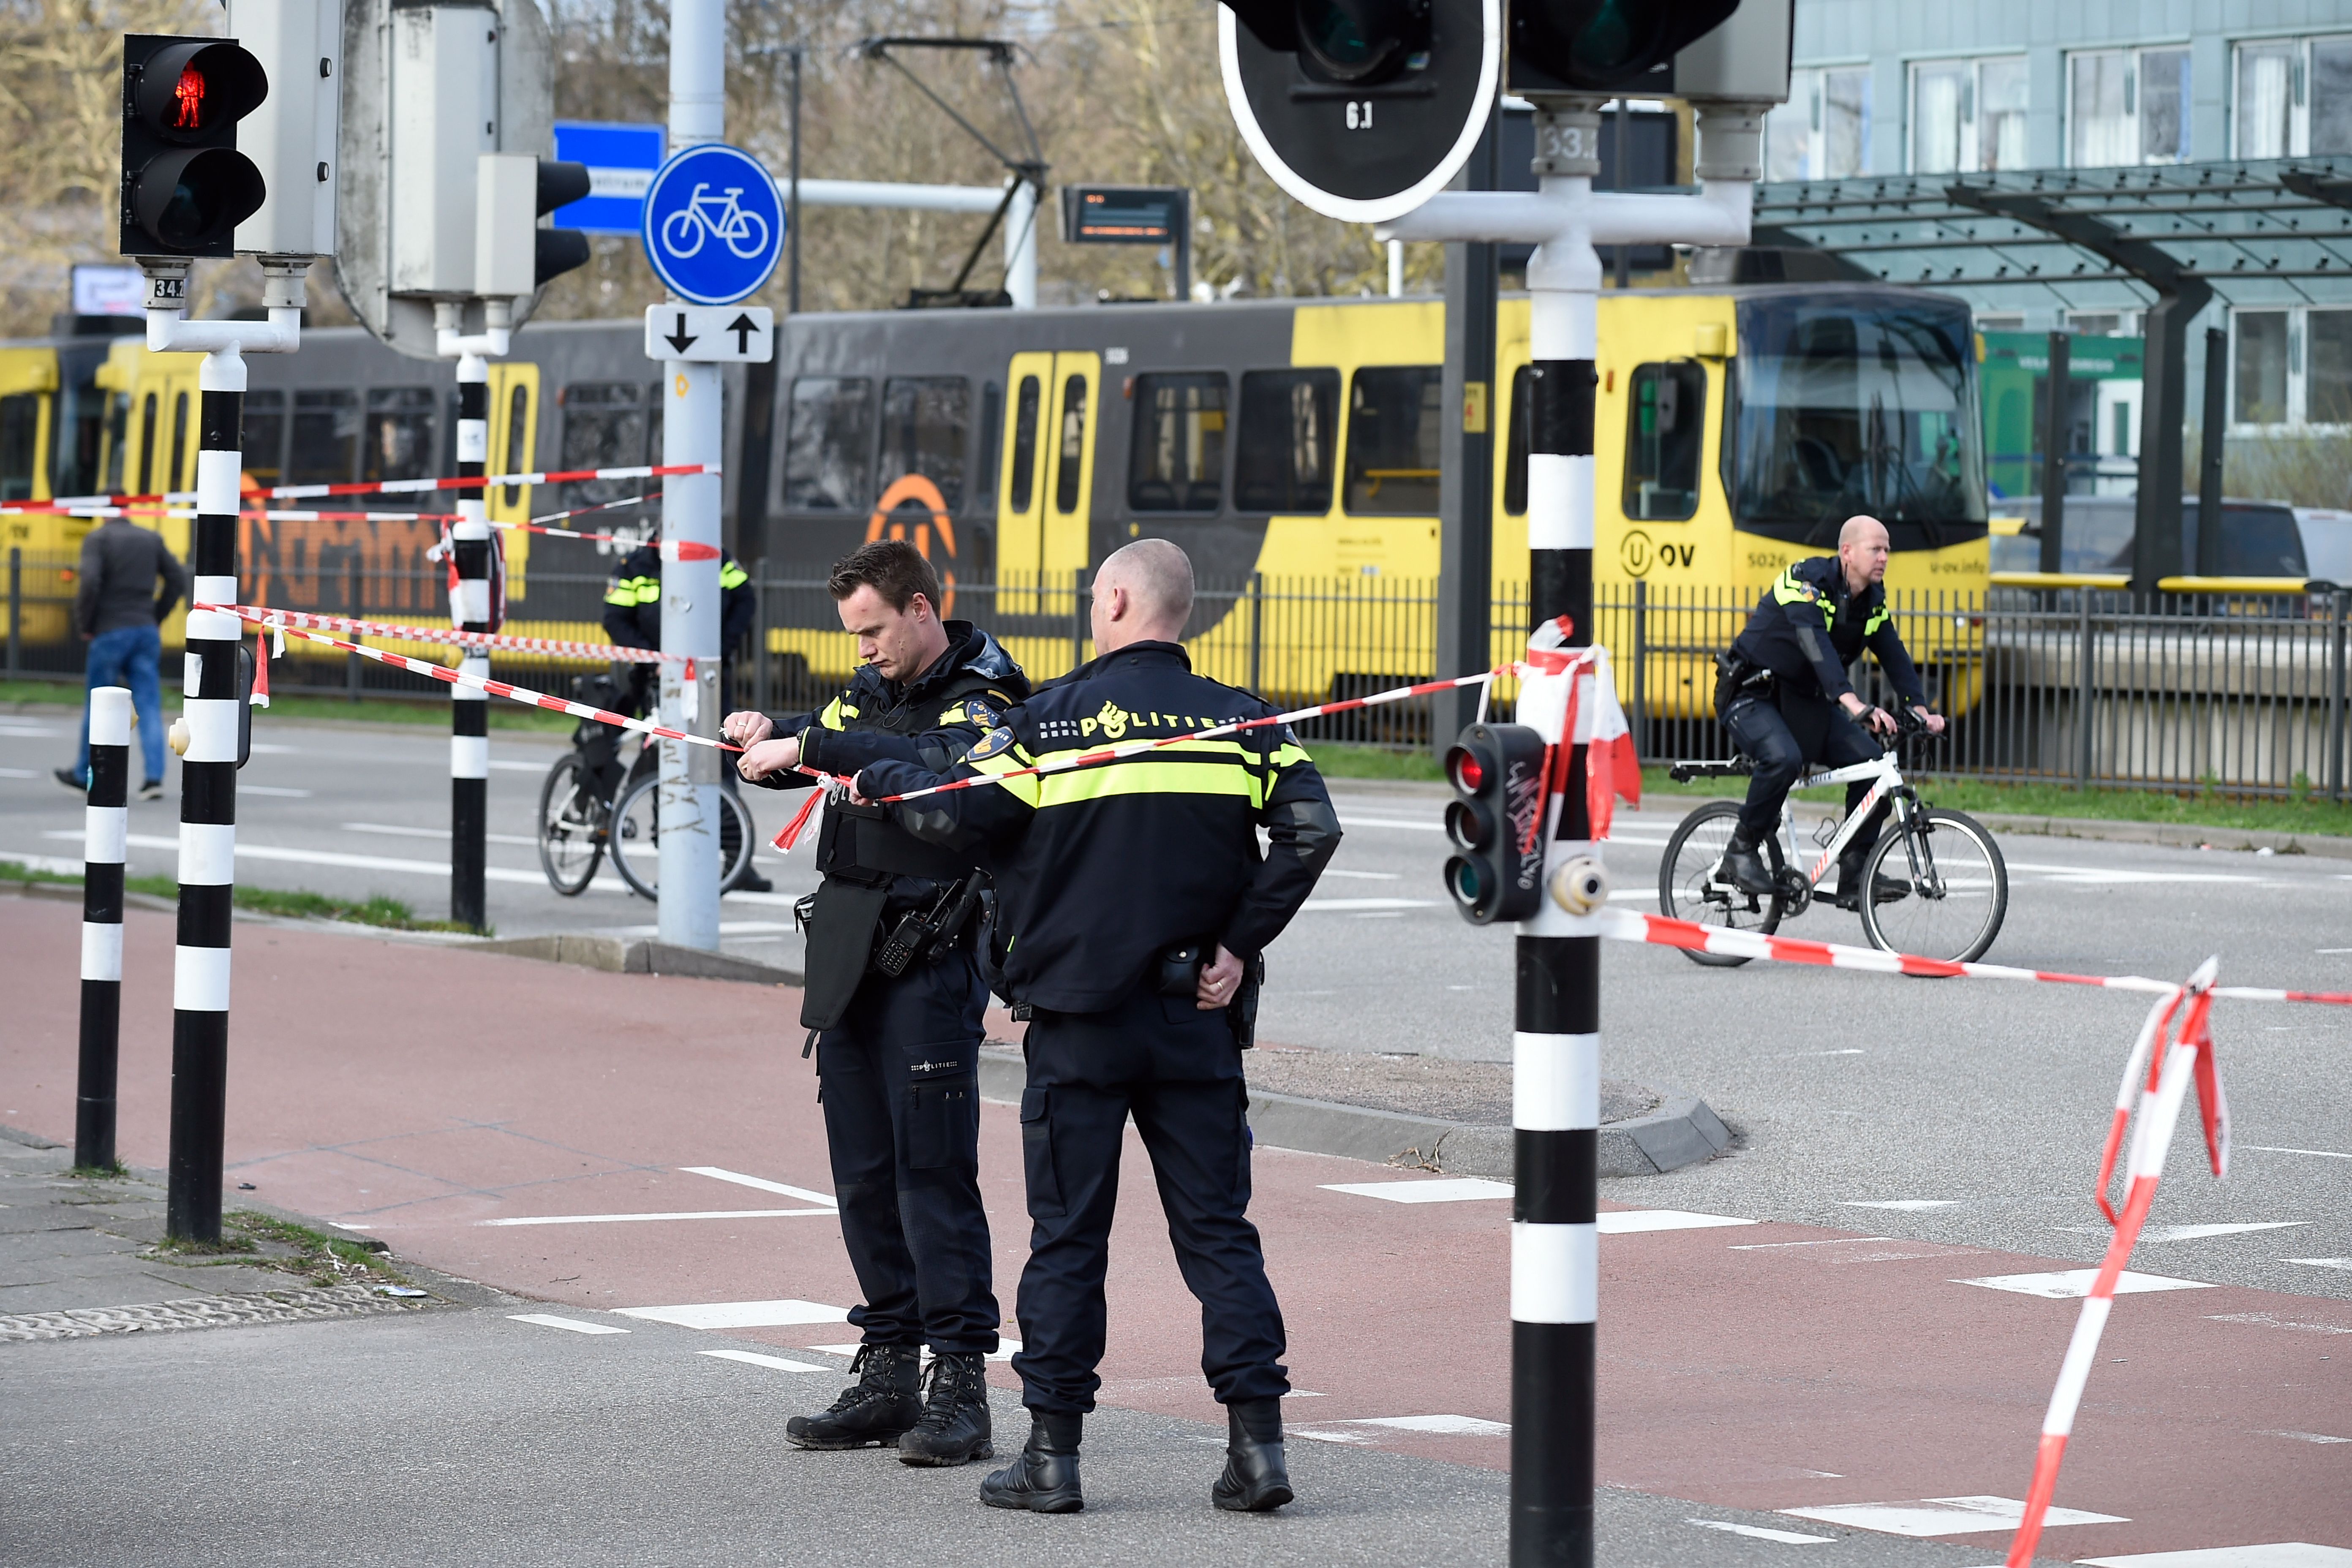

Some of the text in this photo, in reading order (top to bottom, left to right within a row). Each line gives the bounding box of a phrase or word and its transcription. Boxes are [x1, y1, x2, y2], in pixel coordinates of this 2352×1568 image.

[1346, 101, 1372, 129] 6.1
[1661, 544, 1695, 567] OV
[1747, 553, 1787, 568] 5026
[973, 702, 998, 720] POLITI
[1080, 703, 1217, 738] POLITIE
[919, 1061, 950, 1072] POLITIE
